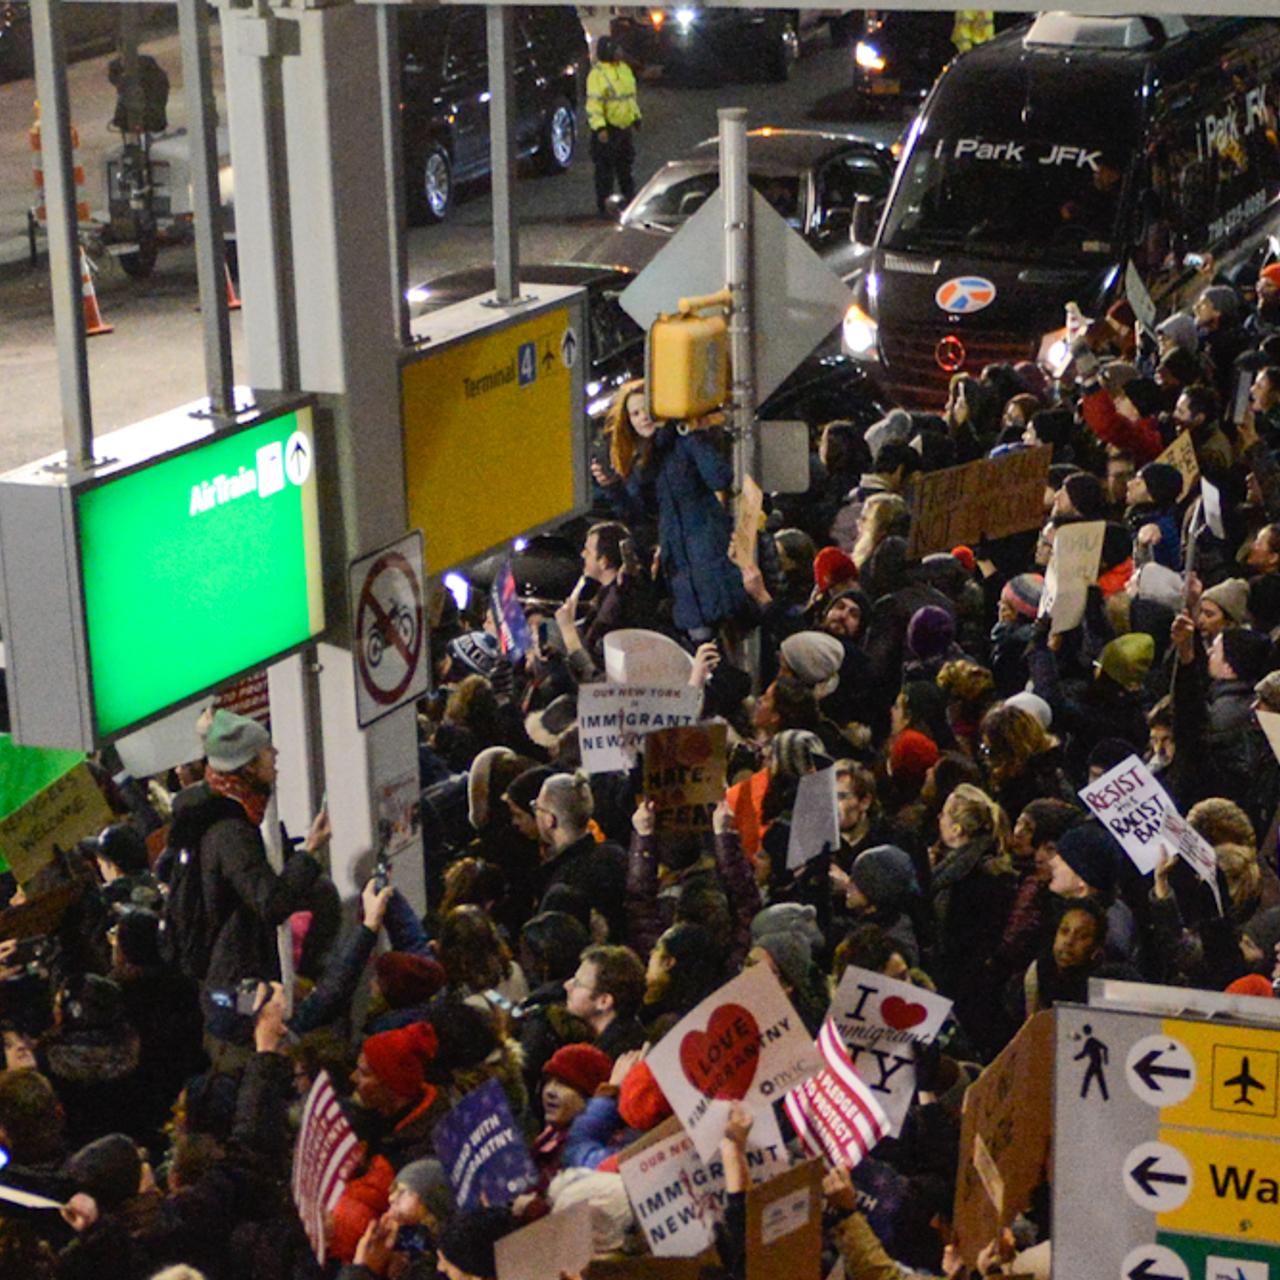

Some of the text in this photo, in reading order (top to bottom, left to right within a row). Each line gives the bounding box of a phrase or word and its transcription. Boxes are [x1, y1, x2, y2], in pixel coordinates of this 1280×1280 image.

[1204, 105, 1239, 158] Park
[954, 139, 1024, 162] Park
[1038, 146, 1102, 172] JFK
[463, 344, 533, 399] Terminal 4
[189, 466, 259, 518] AirTrain
[593, 688, 682, 699] OUR NEW YORK
[583, 734, 622, 750] NEW
[1085, 765, 1145, 812] RESIST
[1109, 793, 1165, 839] RACIST
[845, 984, 879, 1021] I
[696, 1016, 751, 1077] LOVE
[821, 1073, 859, 1118] PLEDGE
[470, 1112, 501, 1147] WITH
[814, 1091, 855, 1146] PROTECT
[637, 1145, 780, 1219] IMMIGRNT
[639, 1149, 666, 1173] OUR
[648, 1207, 696, 1245] NEW
